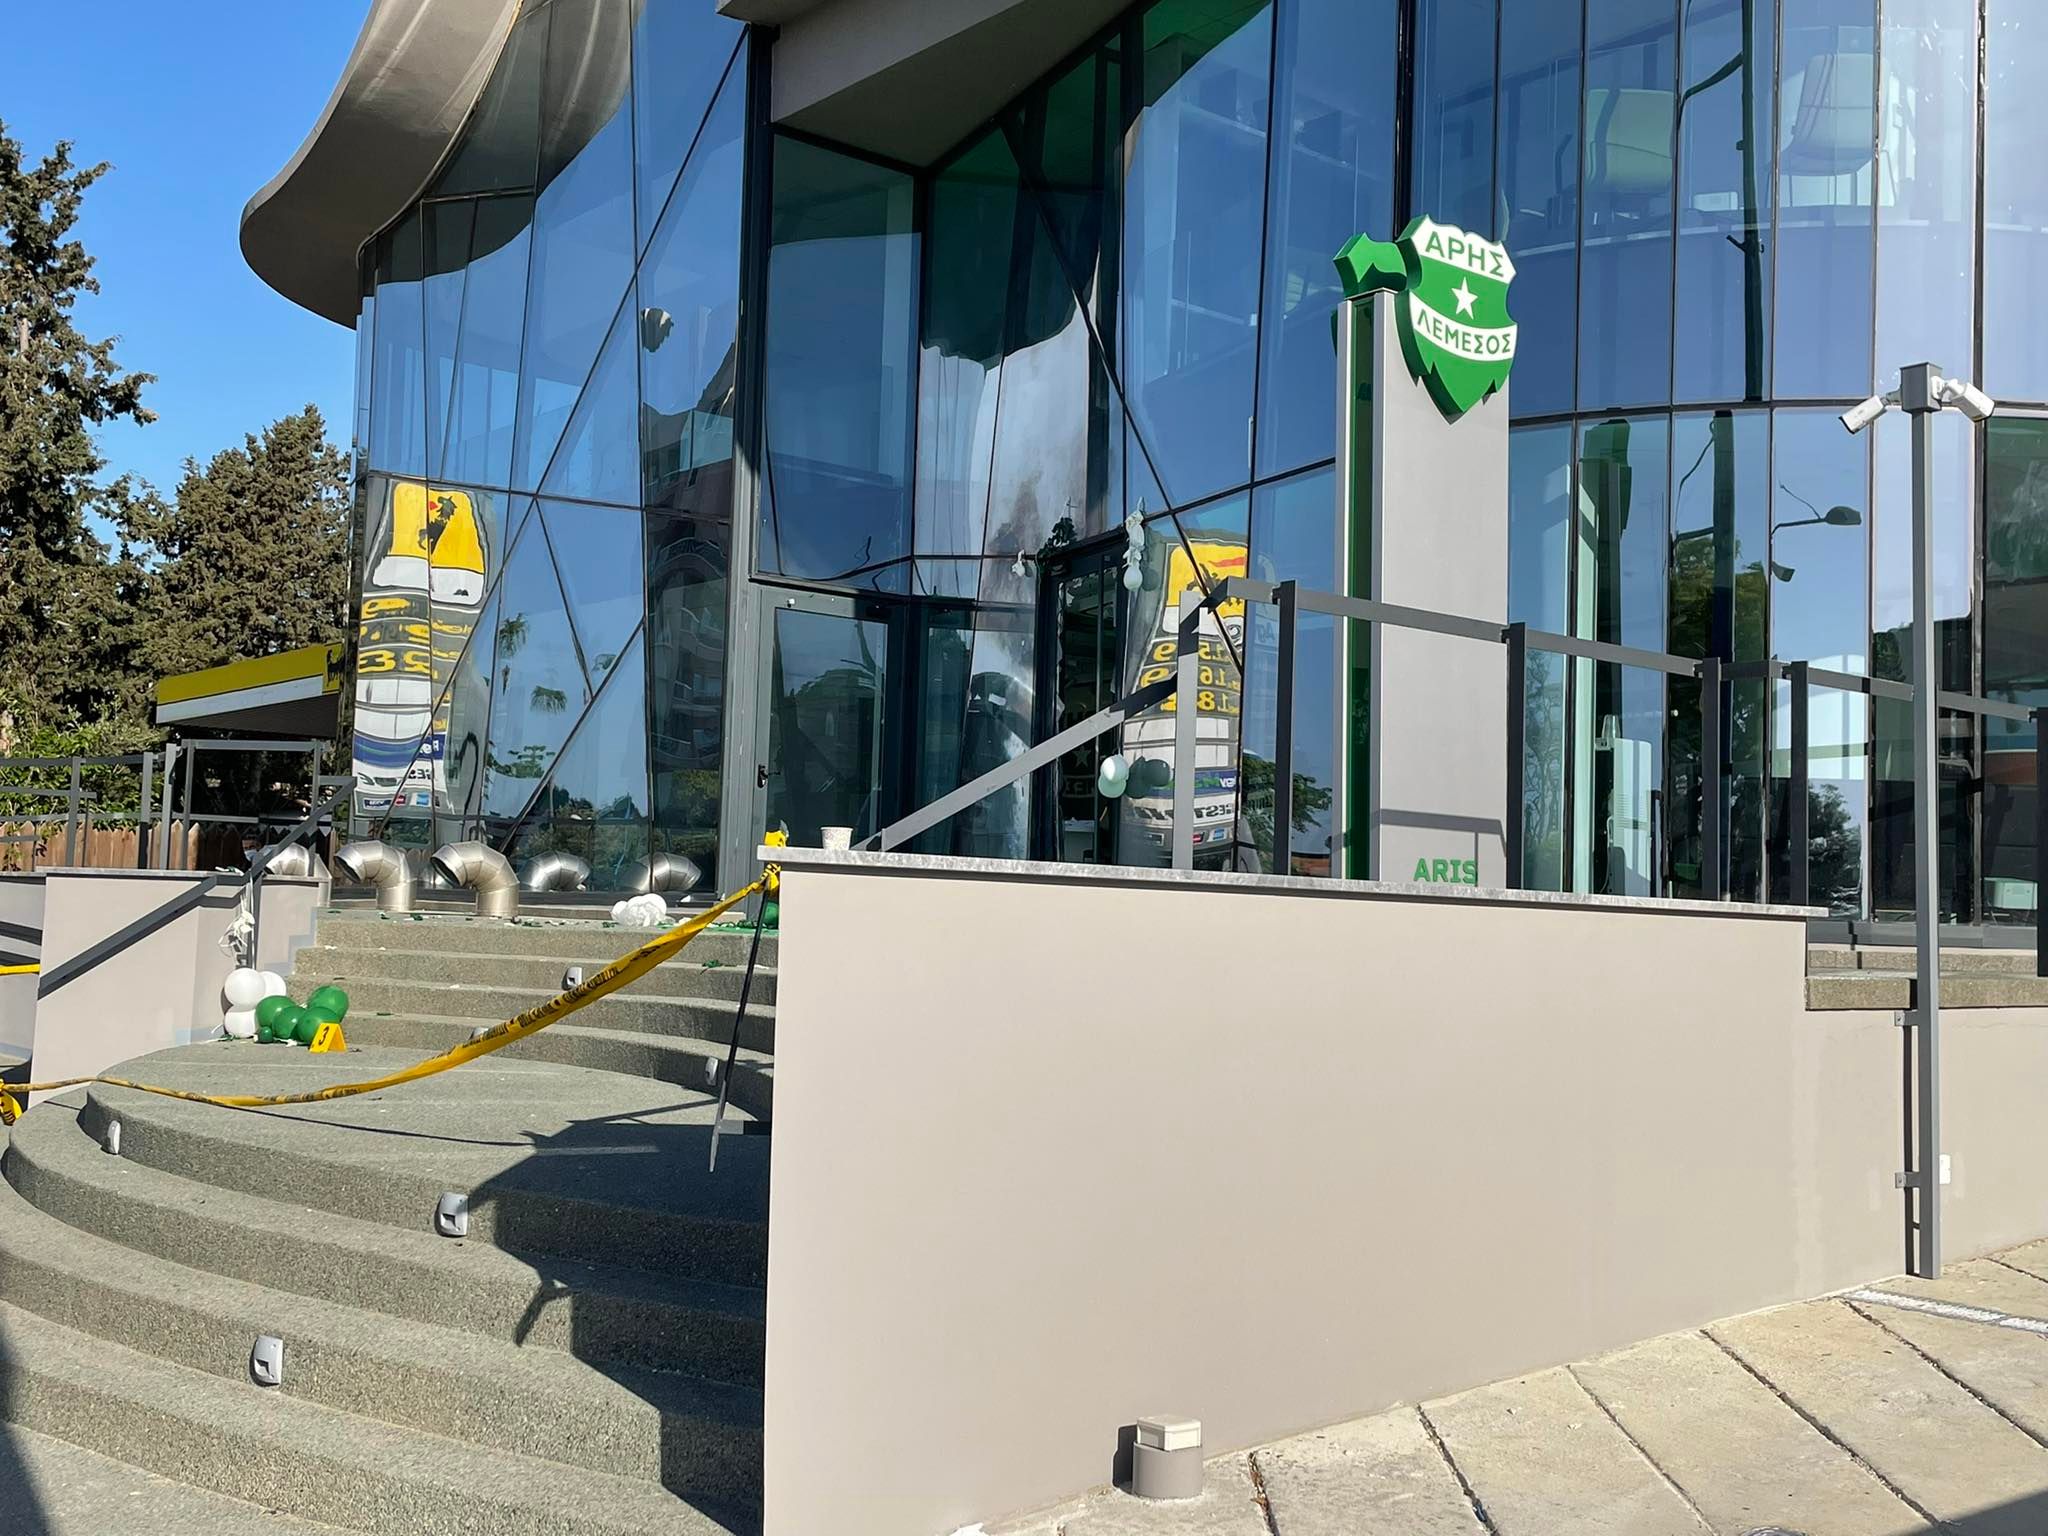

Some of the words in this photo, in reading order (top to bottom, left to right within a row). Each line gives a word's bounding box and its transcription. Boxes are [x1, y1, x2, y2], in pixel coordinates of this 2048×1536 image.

[1425, 231, 1504, 277] ΑΡΗΣ
[1417, 308, 1511, 355] ΛΕΜΕΣΟΣ
[1413, 858, 1477, 884] ARIS
